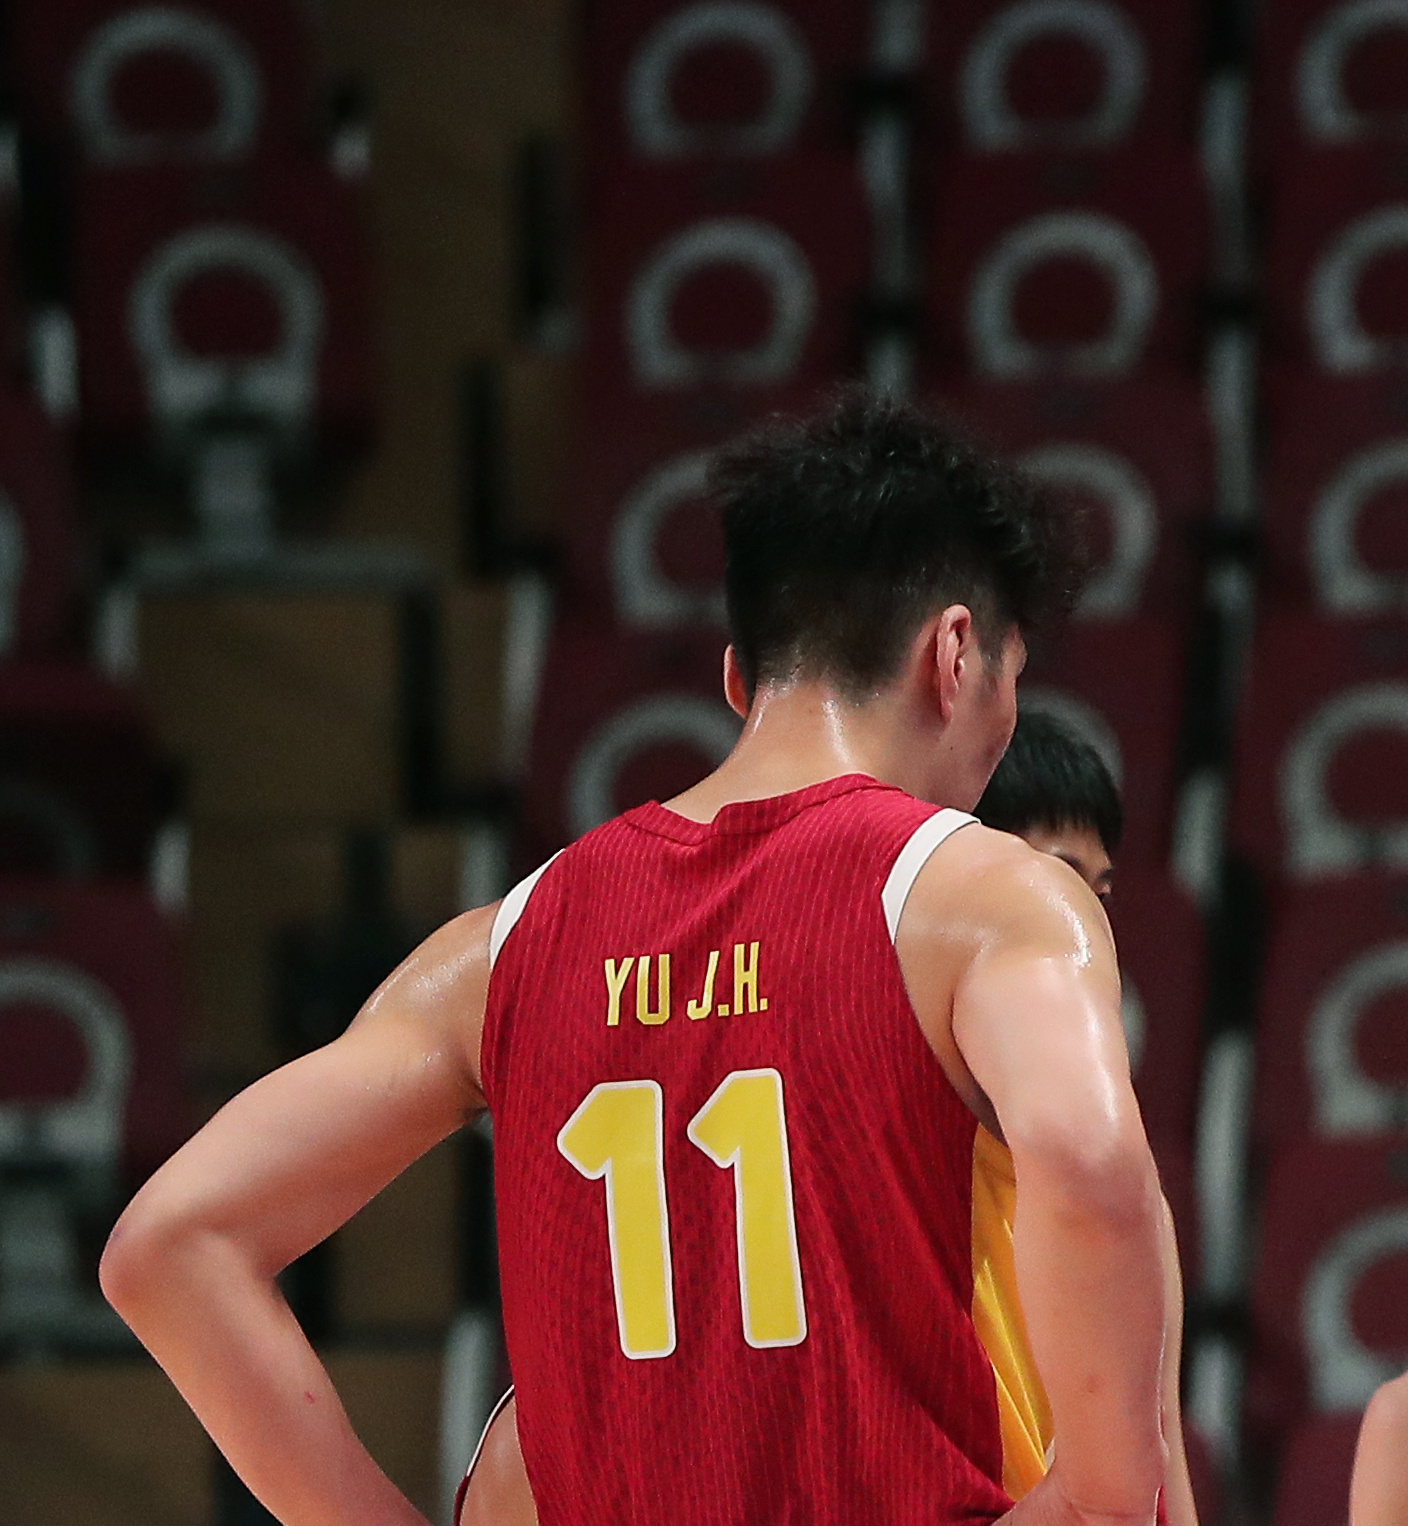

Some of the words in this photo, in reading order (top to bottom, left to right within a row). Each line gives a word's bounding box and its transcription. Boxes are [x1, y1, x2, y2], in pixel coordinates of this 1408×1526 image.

[604, 953, 671, 1026] YU
[687, 941, 769, 1020] J.H.
[556, 1067, 808, 1361] 11
